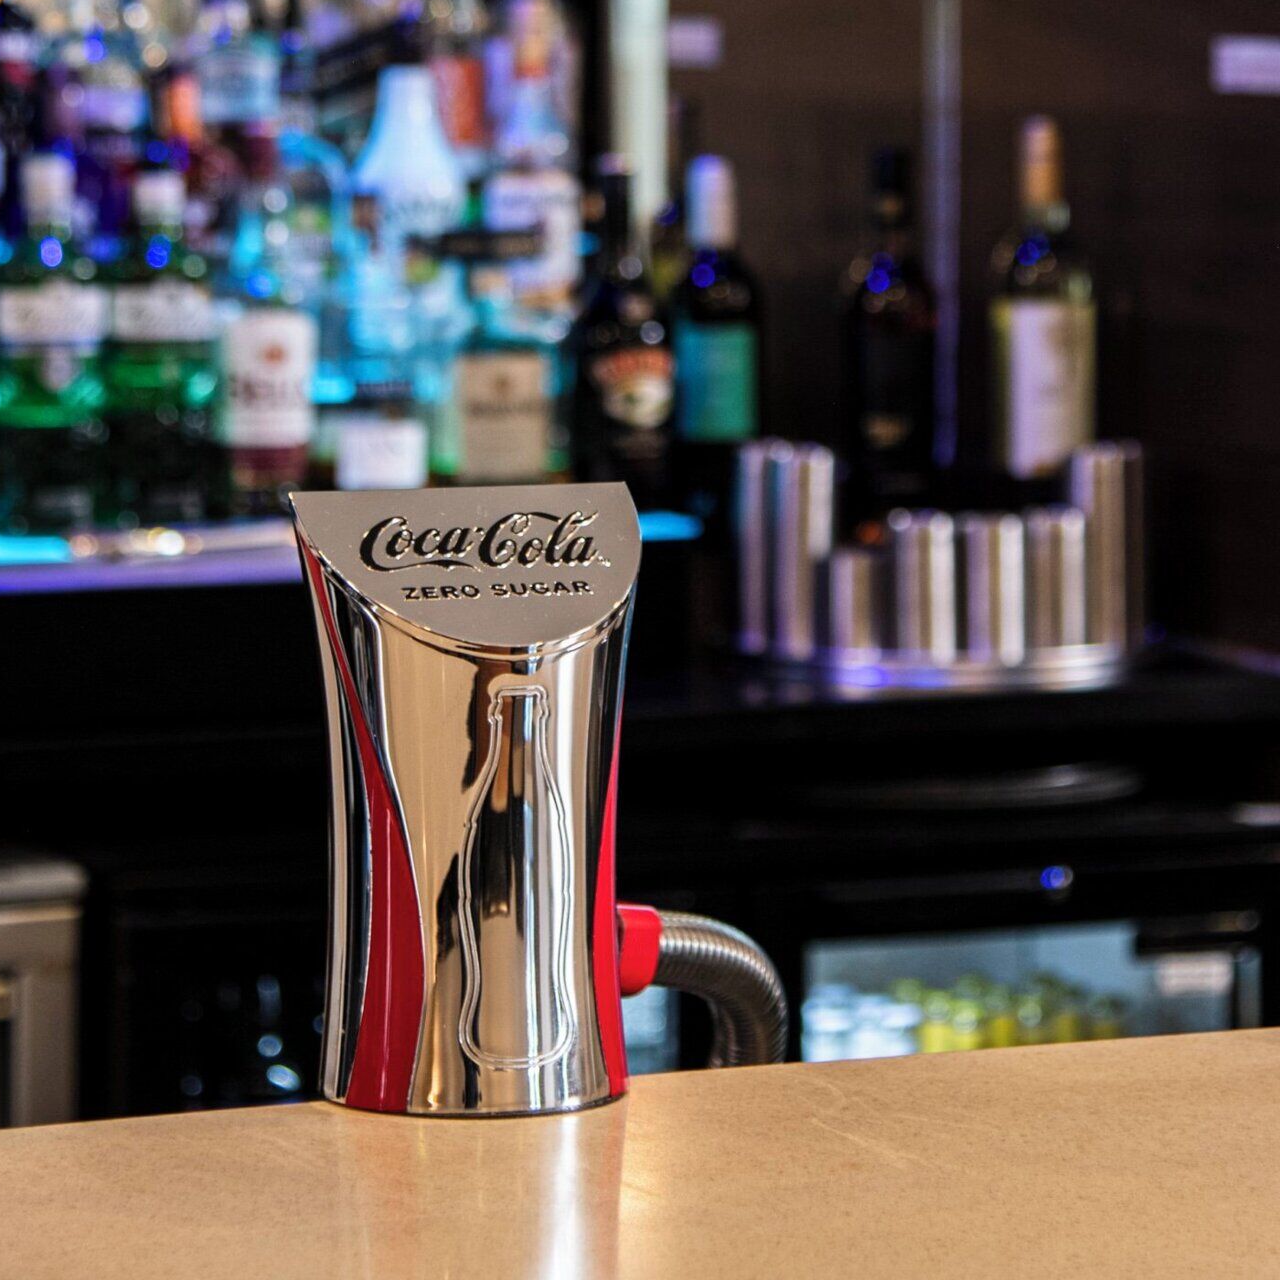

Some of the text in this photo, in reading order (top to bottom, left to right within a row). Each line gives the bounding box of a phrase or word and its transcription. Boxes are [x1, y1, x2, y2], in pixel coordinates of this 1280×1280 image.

[360, 511, 599, 572] Coca-Cola
[401, 580, 595, 602] ZERO SUGAR
